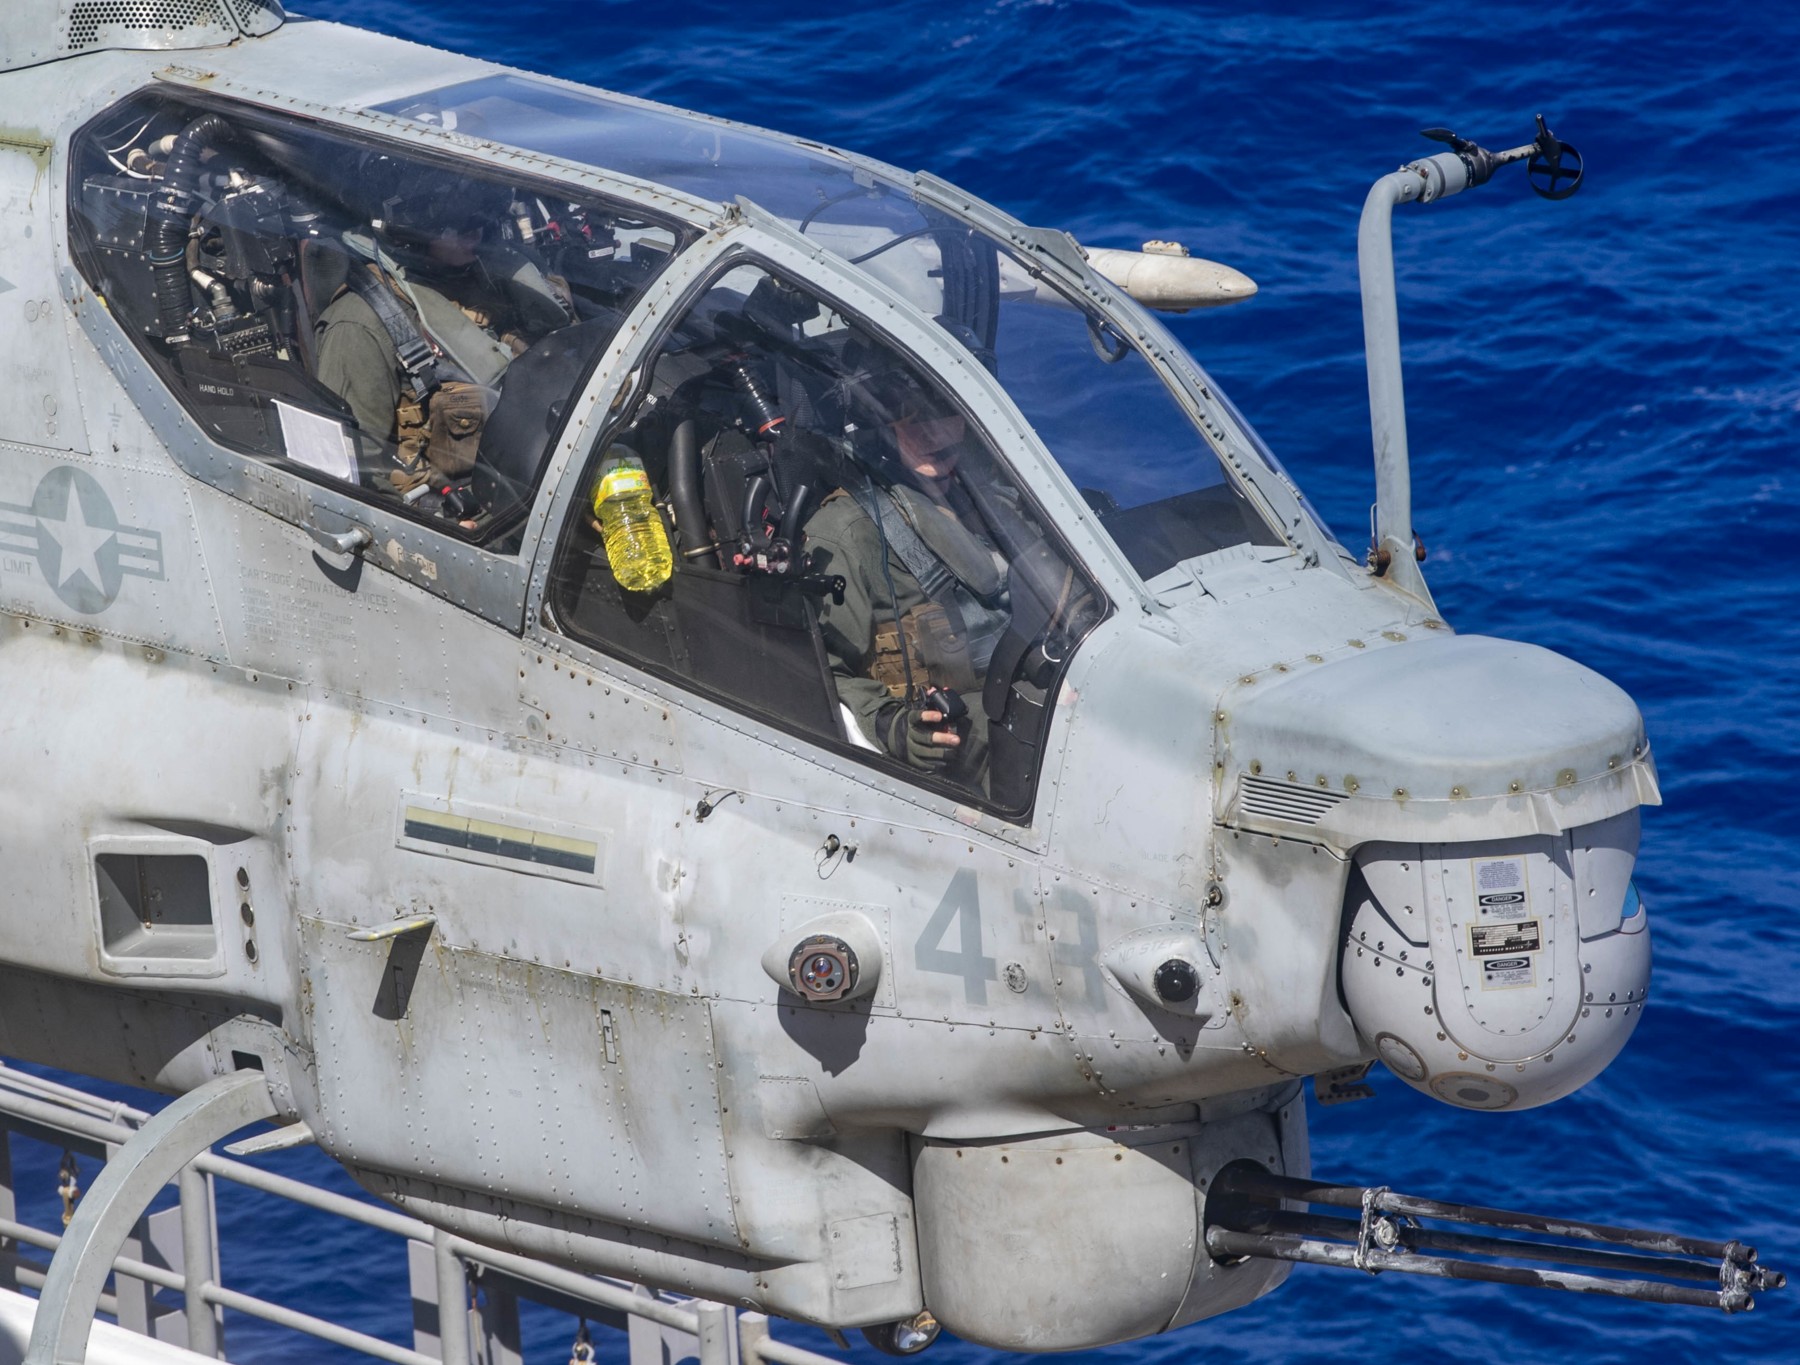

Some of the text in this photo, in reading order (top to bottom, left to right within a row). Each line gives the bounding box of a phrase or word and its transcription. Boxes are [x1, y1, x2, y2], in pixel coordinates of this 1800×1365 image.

[199, 384, 234, 396] HAND HOLD
[247, 464, 287, 492] CLOSE
[258, 492, 290, 517] OPEN
[3, 558, 33, 576] LIMIT
[240, 566, 389, 608] CARTRIDGE ACTIVATED DEVICES
[1491, 895, 1513, 903] DANGER
[1497, 960, 1518, 968] DANGER
